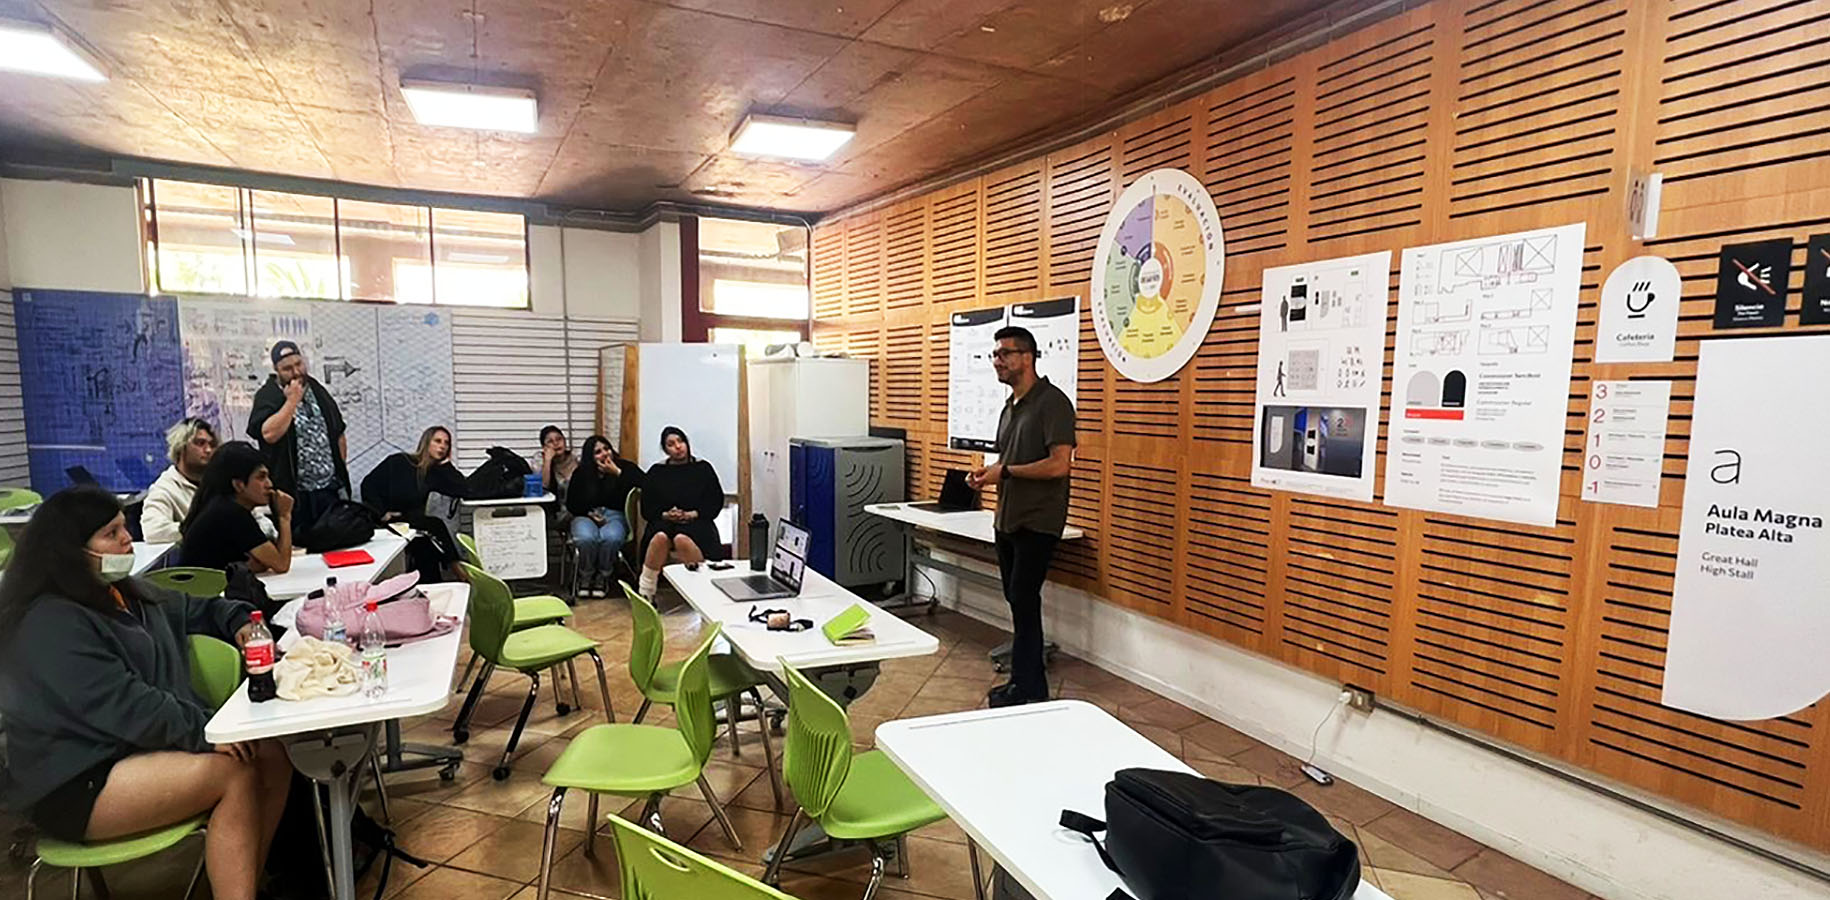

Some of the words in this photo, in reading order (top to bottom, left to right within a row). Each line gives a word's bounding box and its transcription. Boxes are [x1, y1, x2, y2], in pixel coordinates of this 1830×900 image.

[1734, 303, 1765, 311] Silencio
[1596, 384, 1608, 400] 3
[1593, 408, 1605, 423] 2
[1594, 433, 1600, 448] 1
[1589, 454, 1601, 470] 0
[1710, 449, 1741, 484] a
[1587, 480, 1598, 494] -1
[1707, 504, 1749, 521] Aula
[1753, 508, 1823, 529] Magna
[1705, 522, 1755, 539] Platea
[1758, 529, 1794, 543] Alta
[1701, 552, 1733, 565] Great
[1735, 557, 1759, 568] Hall
[1700, 565, 1727, 577] High
[1728, 568, 1754, 580] Stall
